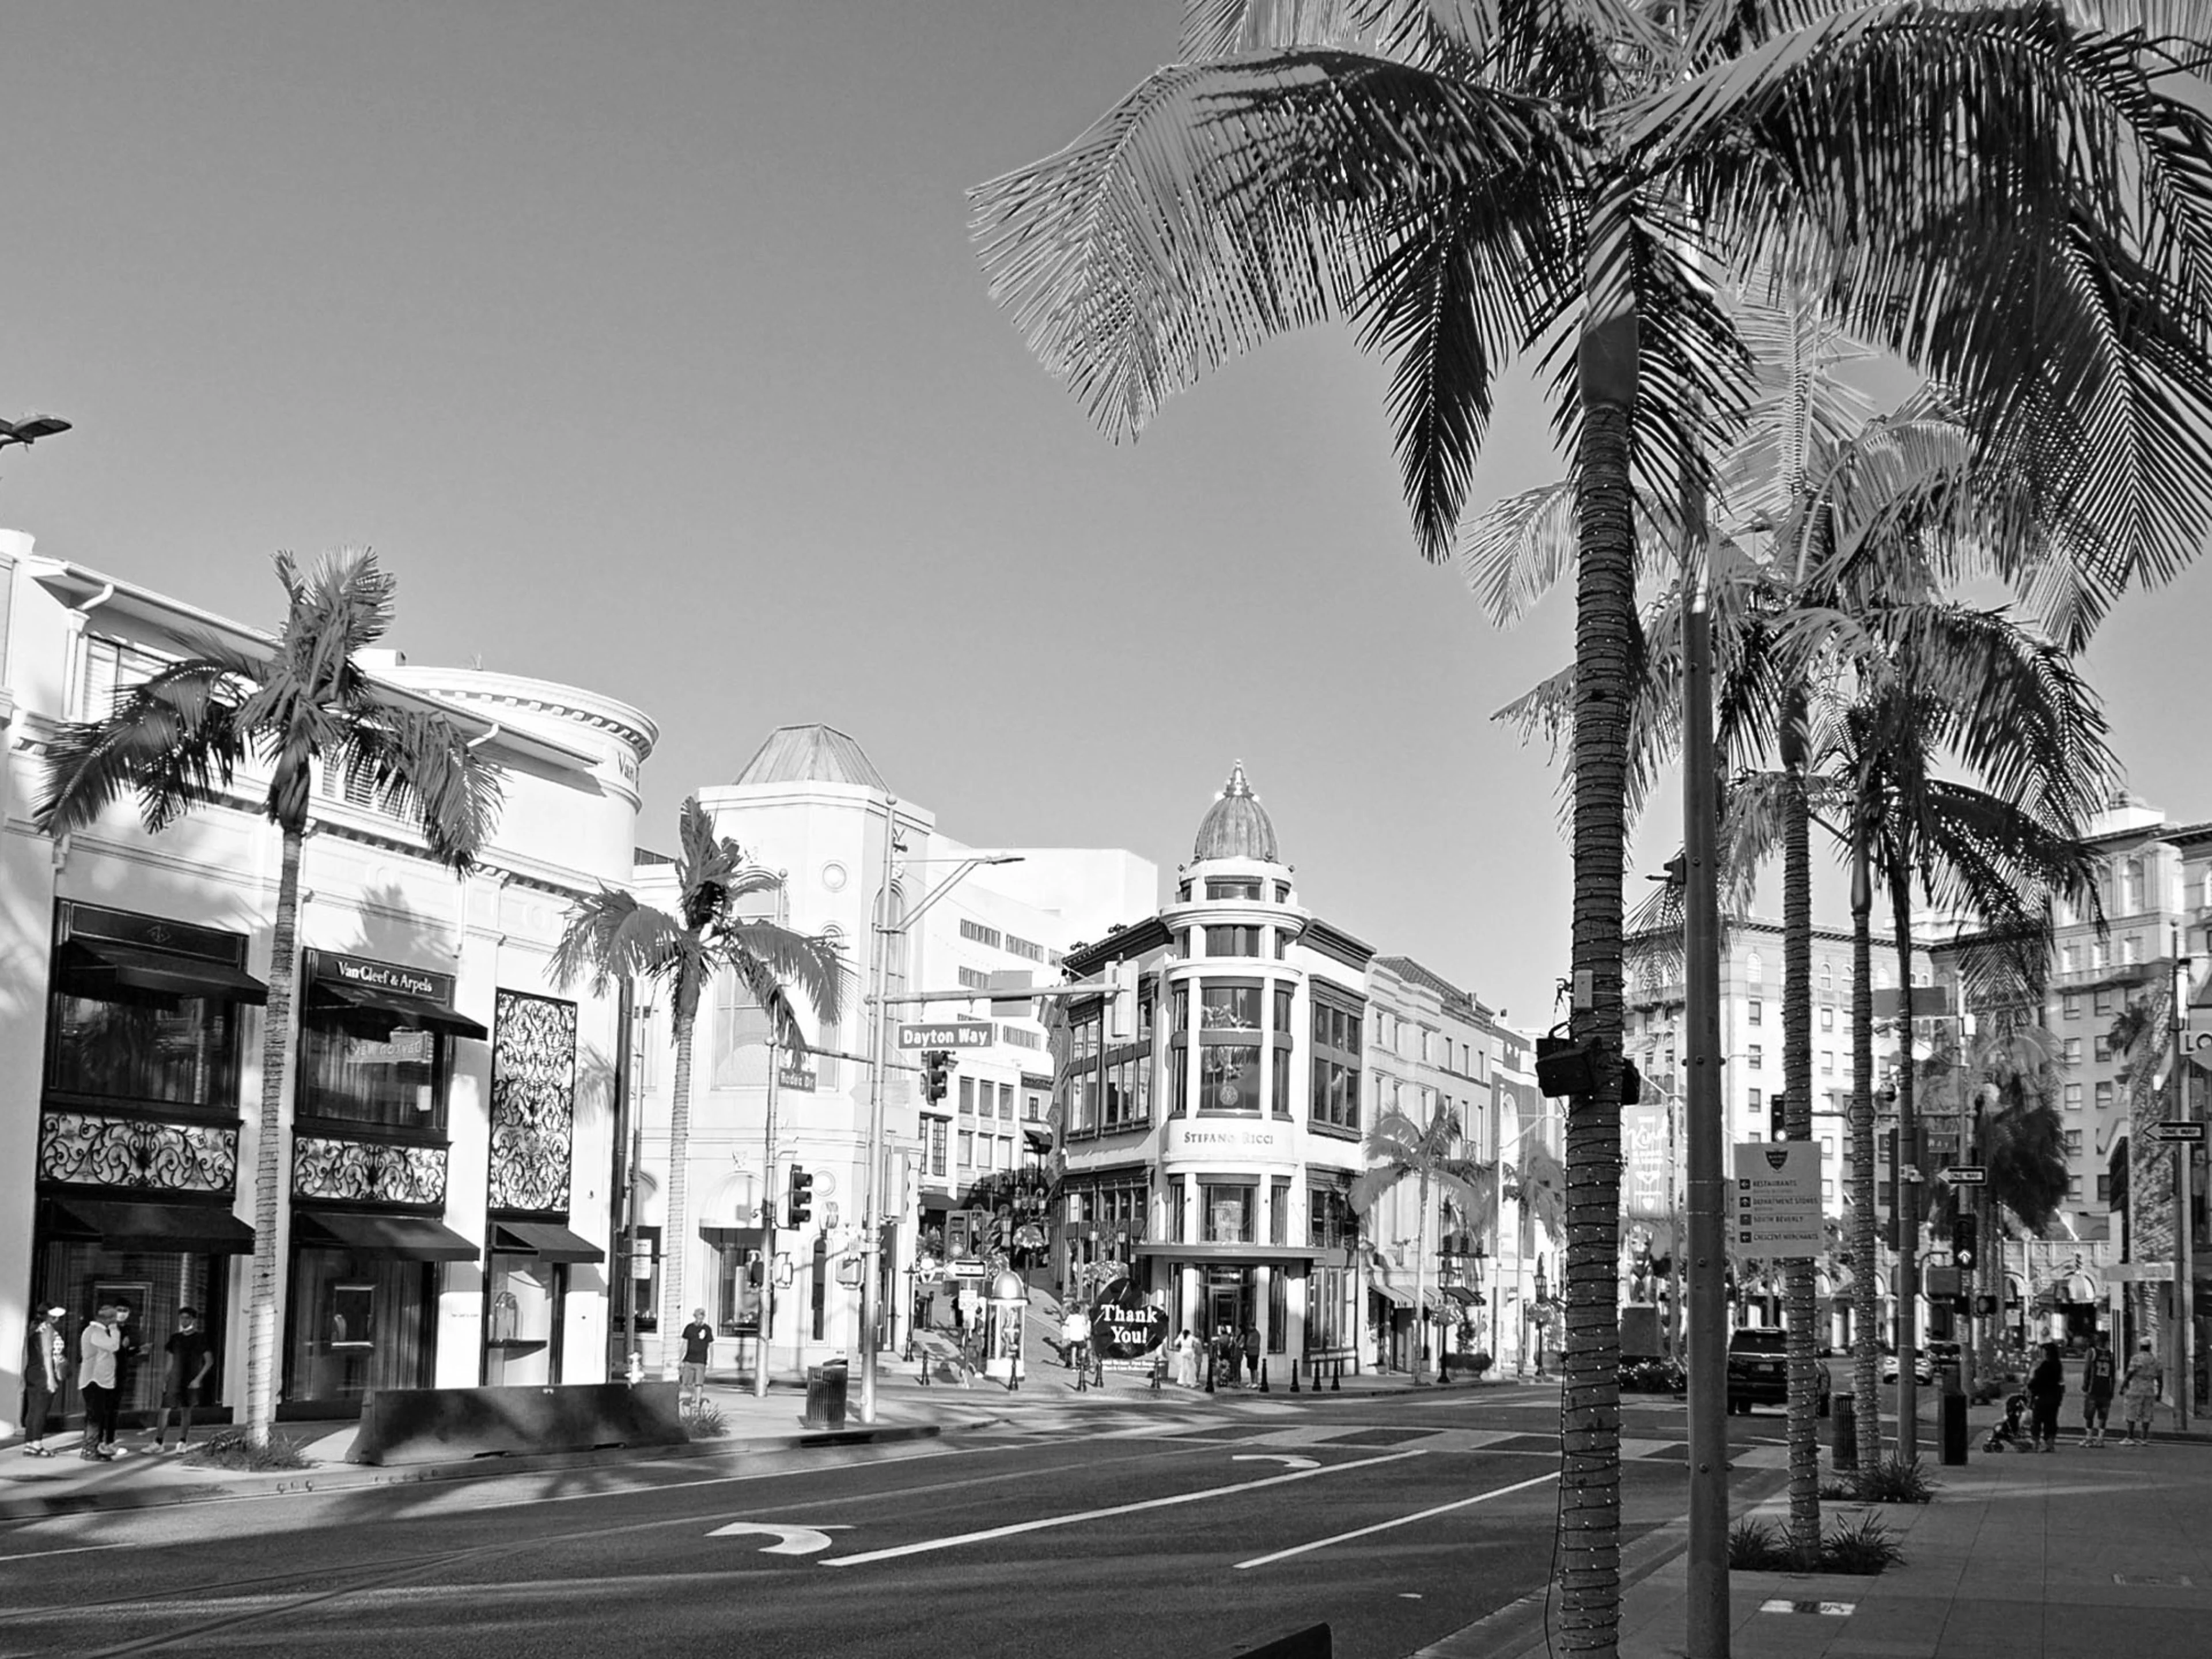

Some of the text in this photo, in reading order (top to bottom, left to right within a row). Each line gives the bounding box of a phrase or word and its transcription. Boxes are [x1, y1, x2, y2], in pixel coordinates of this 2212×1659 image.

[336, 960, 432, 994] Van Cleef & Arpels
[903, 1028, 987, 1047] Dayton Way
[1101, 1304, 1158, 1323] Thank
[1110, 1325, 1147, 1344] You!
